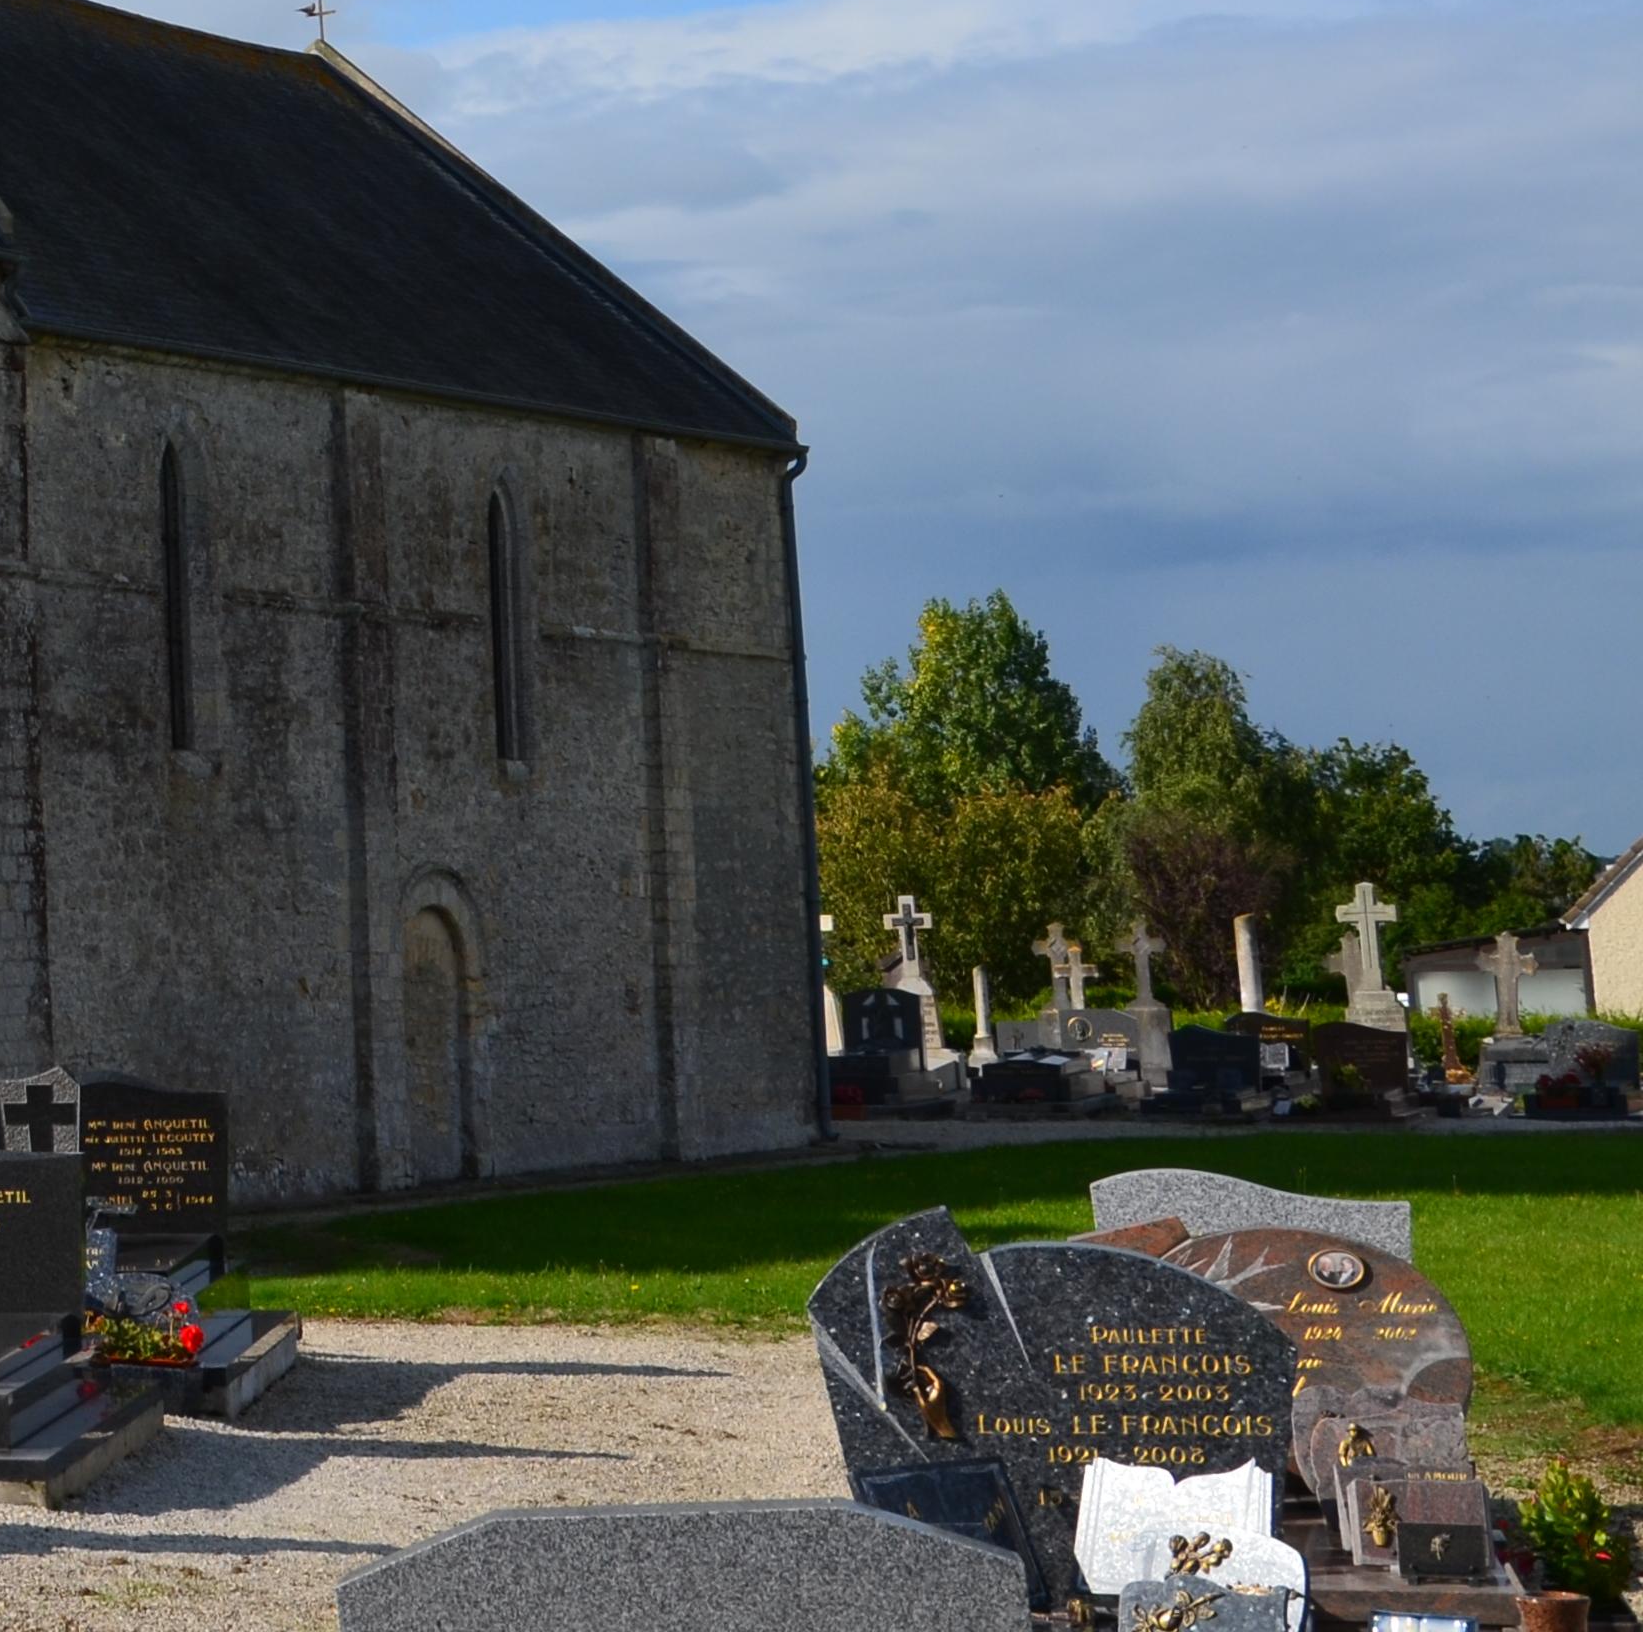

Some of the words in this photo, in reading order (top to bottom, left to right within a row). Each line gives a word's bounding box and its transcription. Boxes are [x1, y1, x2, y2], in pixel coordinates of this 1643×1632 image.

[144, 1118, 210, 1131] ANQUETIL
[143, 1160, 208, 1174] ANQUETIL
[1282, 1290, 1340, 1315] Louis
[1358, 1291, 1439, 1315] Marie
[1090, 1324, 1207, 1344] PAULETTE
[1053, 1353, 1086, 1374] LE
[1103, 1353, 1252, 1377] FRANÇOIS
[1079, 1383, 1137, 1402] 1923
[1159, 1383, 1230, 1402] 2003
[977, 1413, 1051, 1435] LOUIS
[1072, 1414, 1106, 1435] LE
[1122, 1414, 1275, 1437] FRANÇOIS
[1133, 1445, 1206, 1464] 2008
